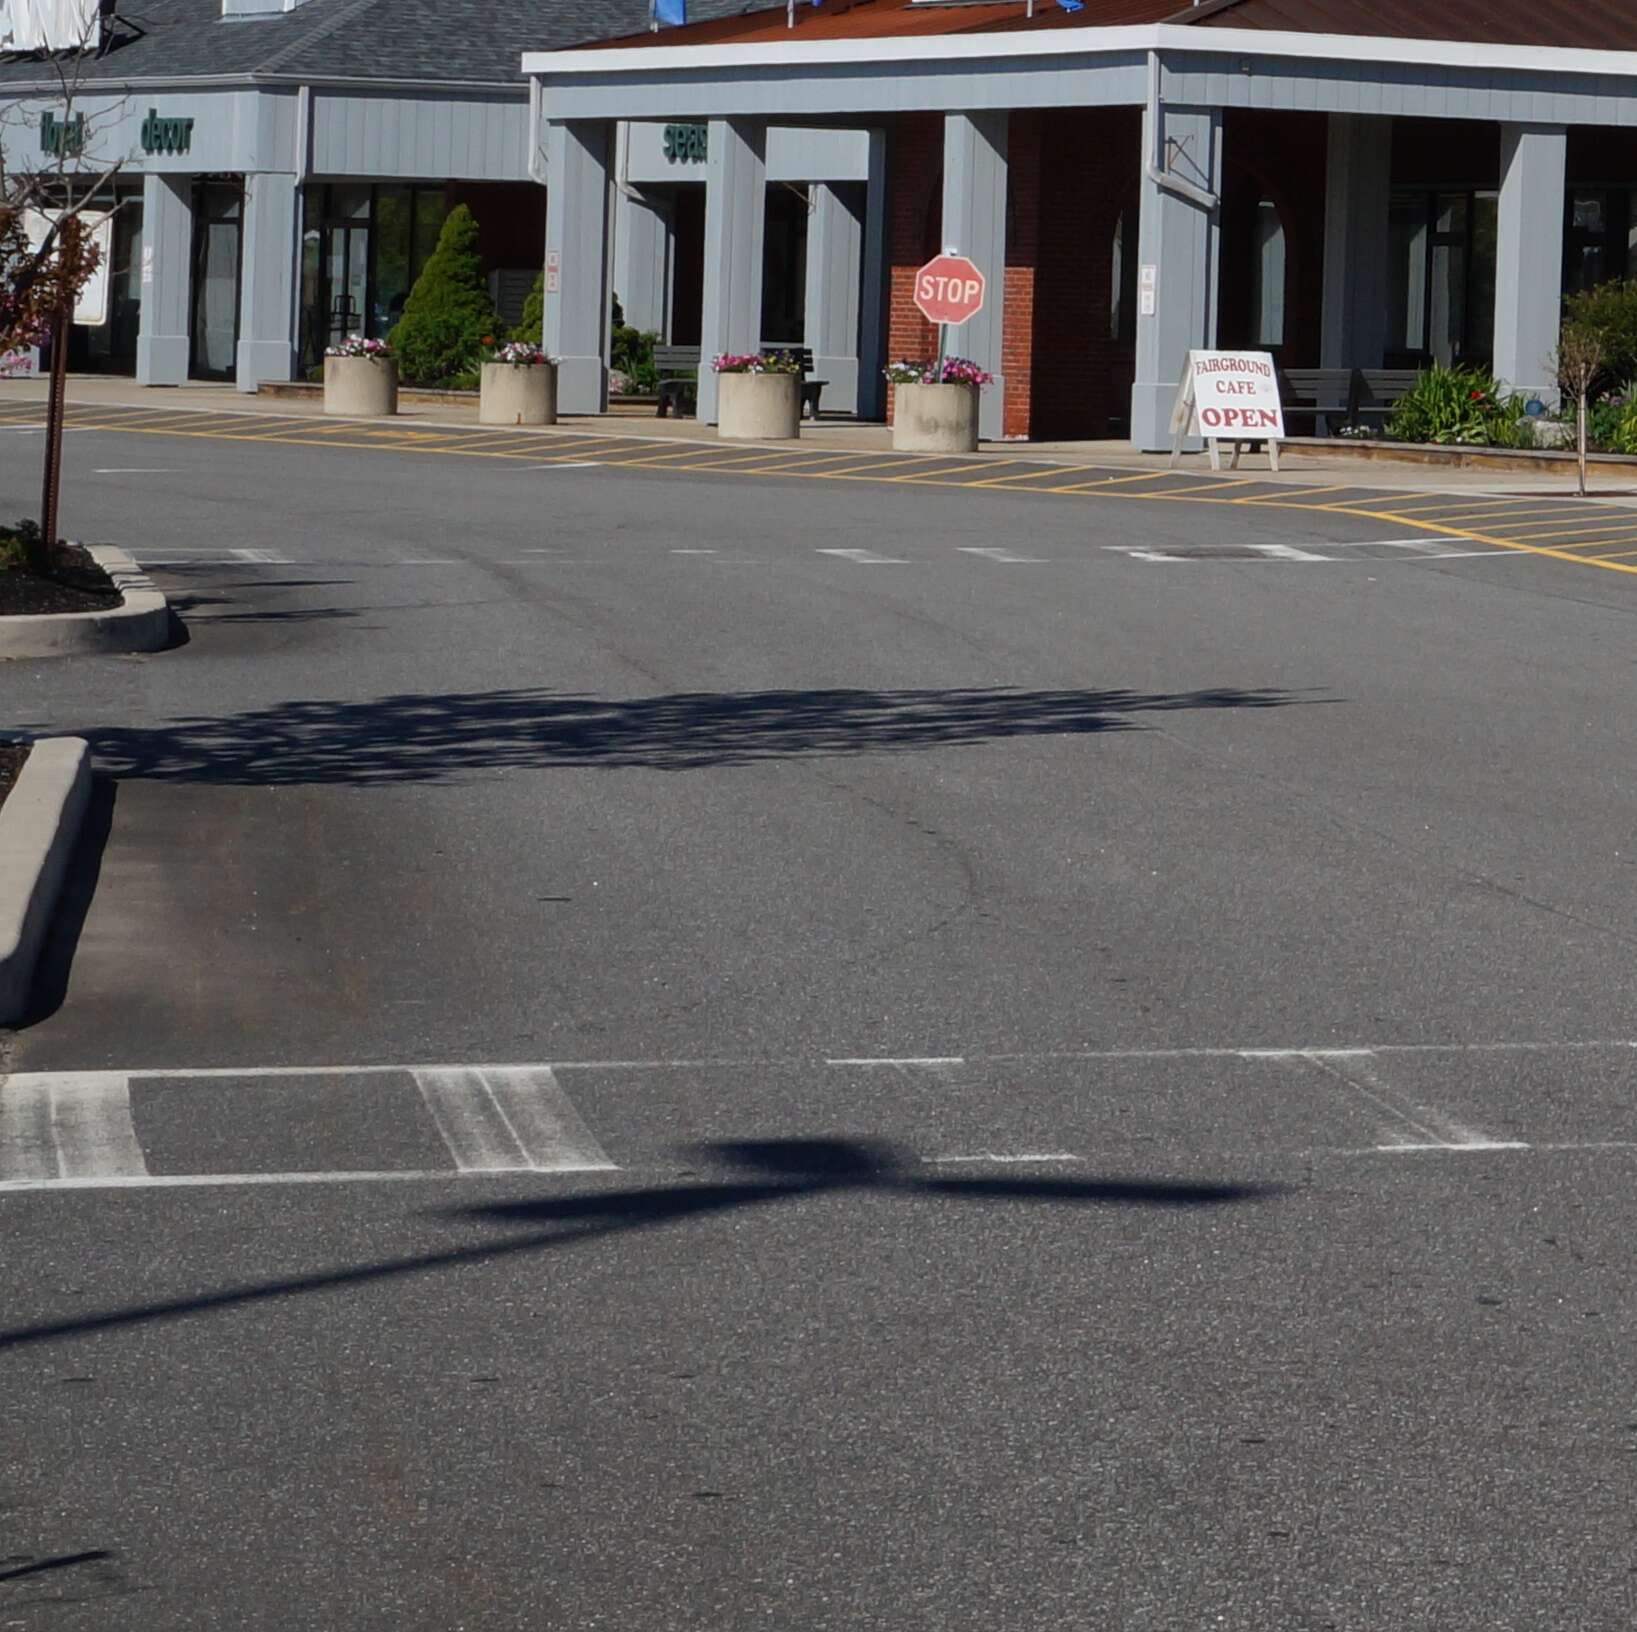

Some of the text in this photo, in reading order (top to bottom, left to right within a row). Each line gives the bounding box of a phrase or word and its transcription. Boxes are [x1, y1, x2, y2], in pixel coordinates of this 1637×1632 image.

[141, 108, 194, 154] decor
[919, 275, 980, 305] STOP
[1195, 357, 1271, 378] FAIRGROUND
[1216, 380, 1257, 395] CAFE
[1201, 407, 1279, 428] OPEN
